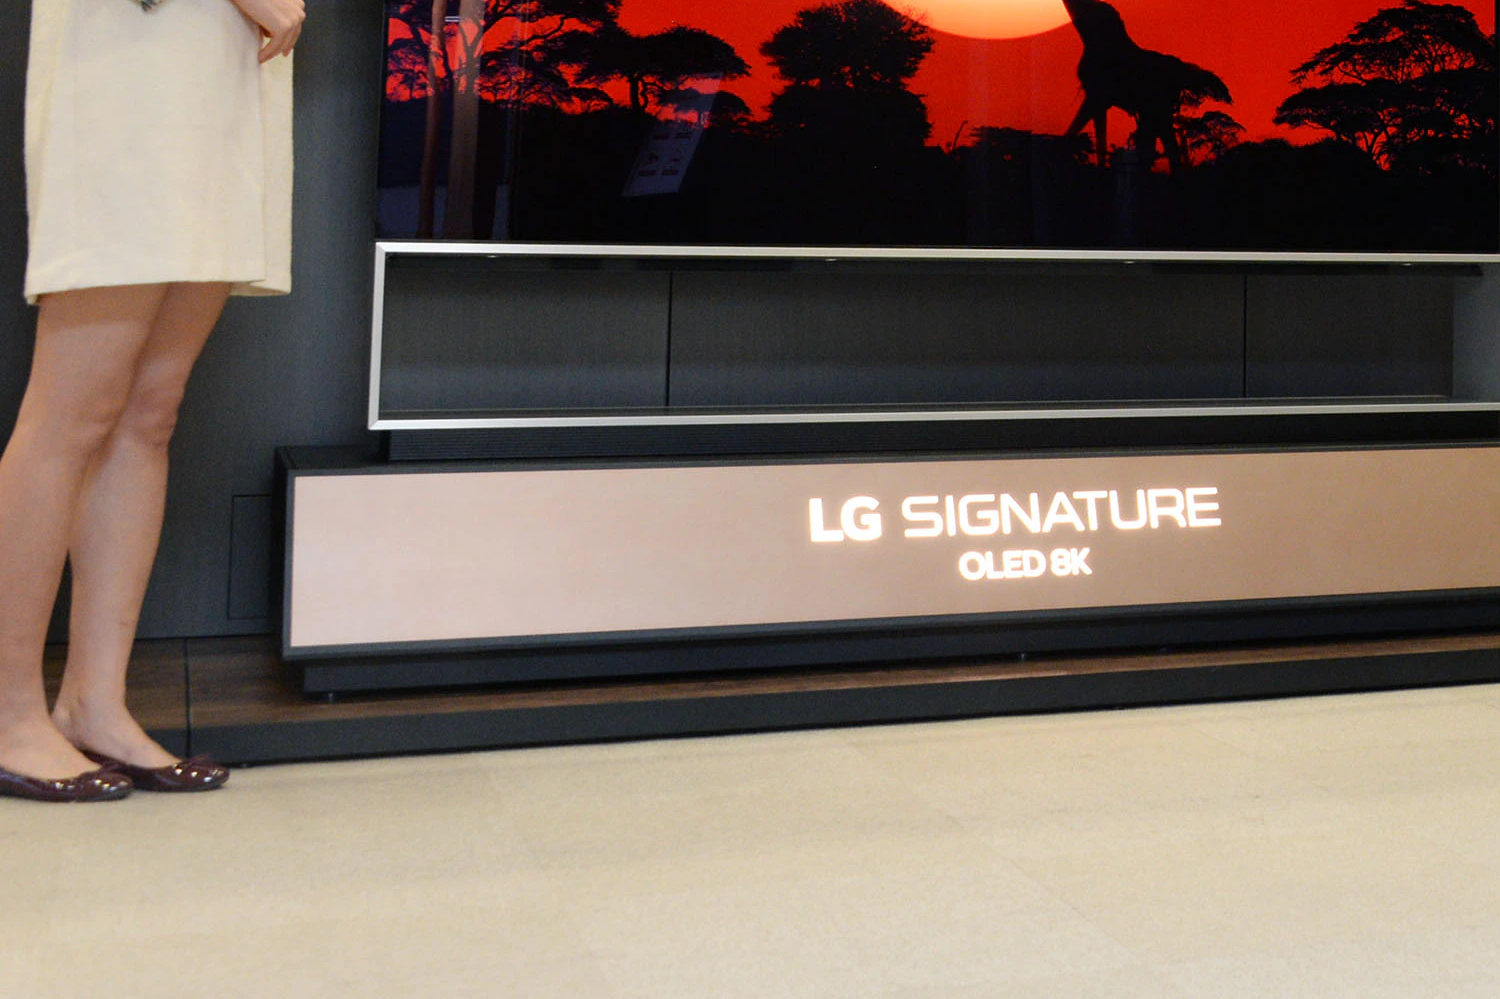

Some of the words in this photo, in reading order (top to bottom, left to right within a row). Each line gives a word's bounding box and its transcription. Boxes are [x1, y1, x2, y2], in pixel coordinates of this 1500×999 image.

[808, 496, 883, 543] LG
[901, 486, 1223, 539] SIGNATURE
[958, 550, 1046, 581] OLED
[1049, 547, 1093, 576] 8K
